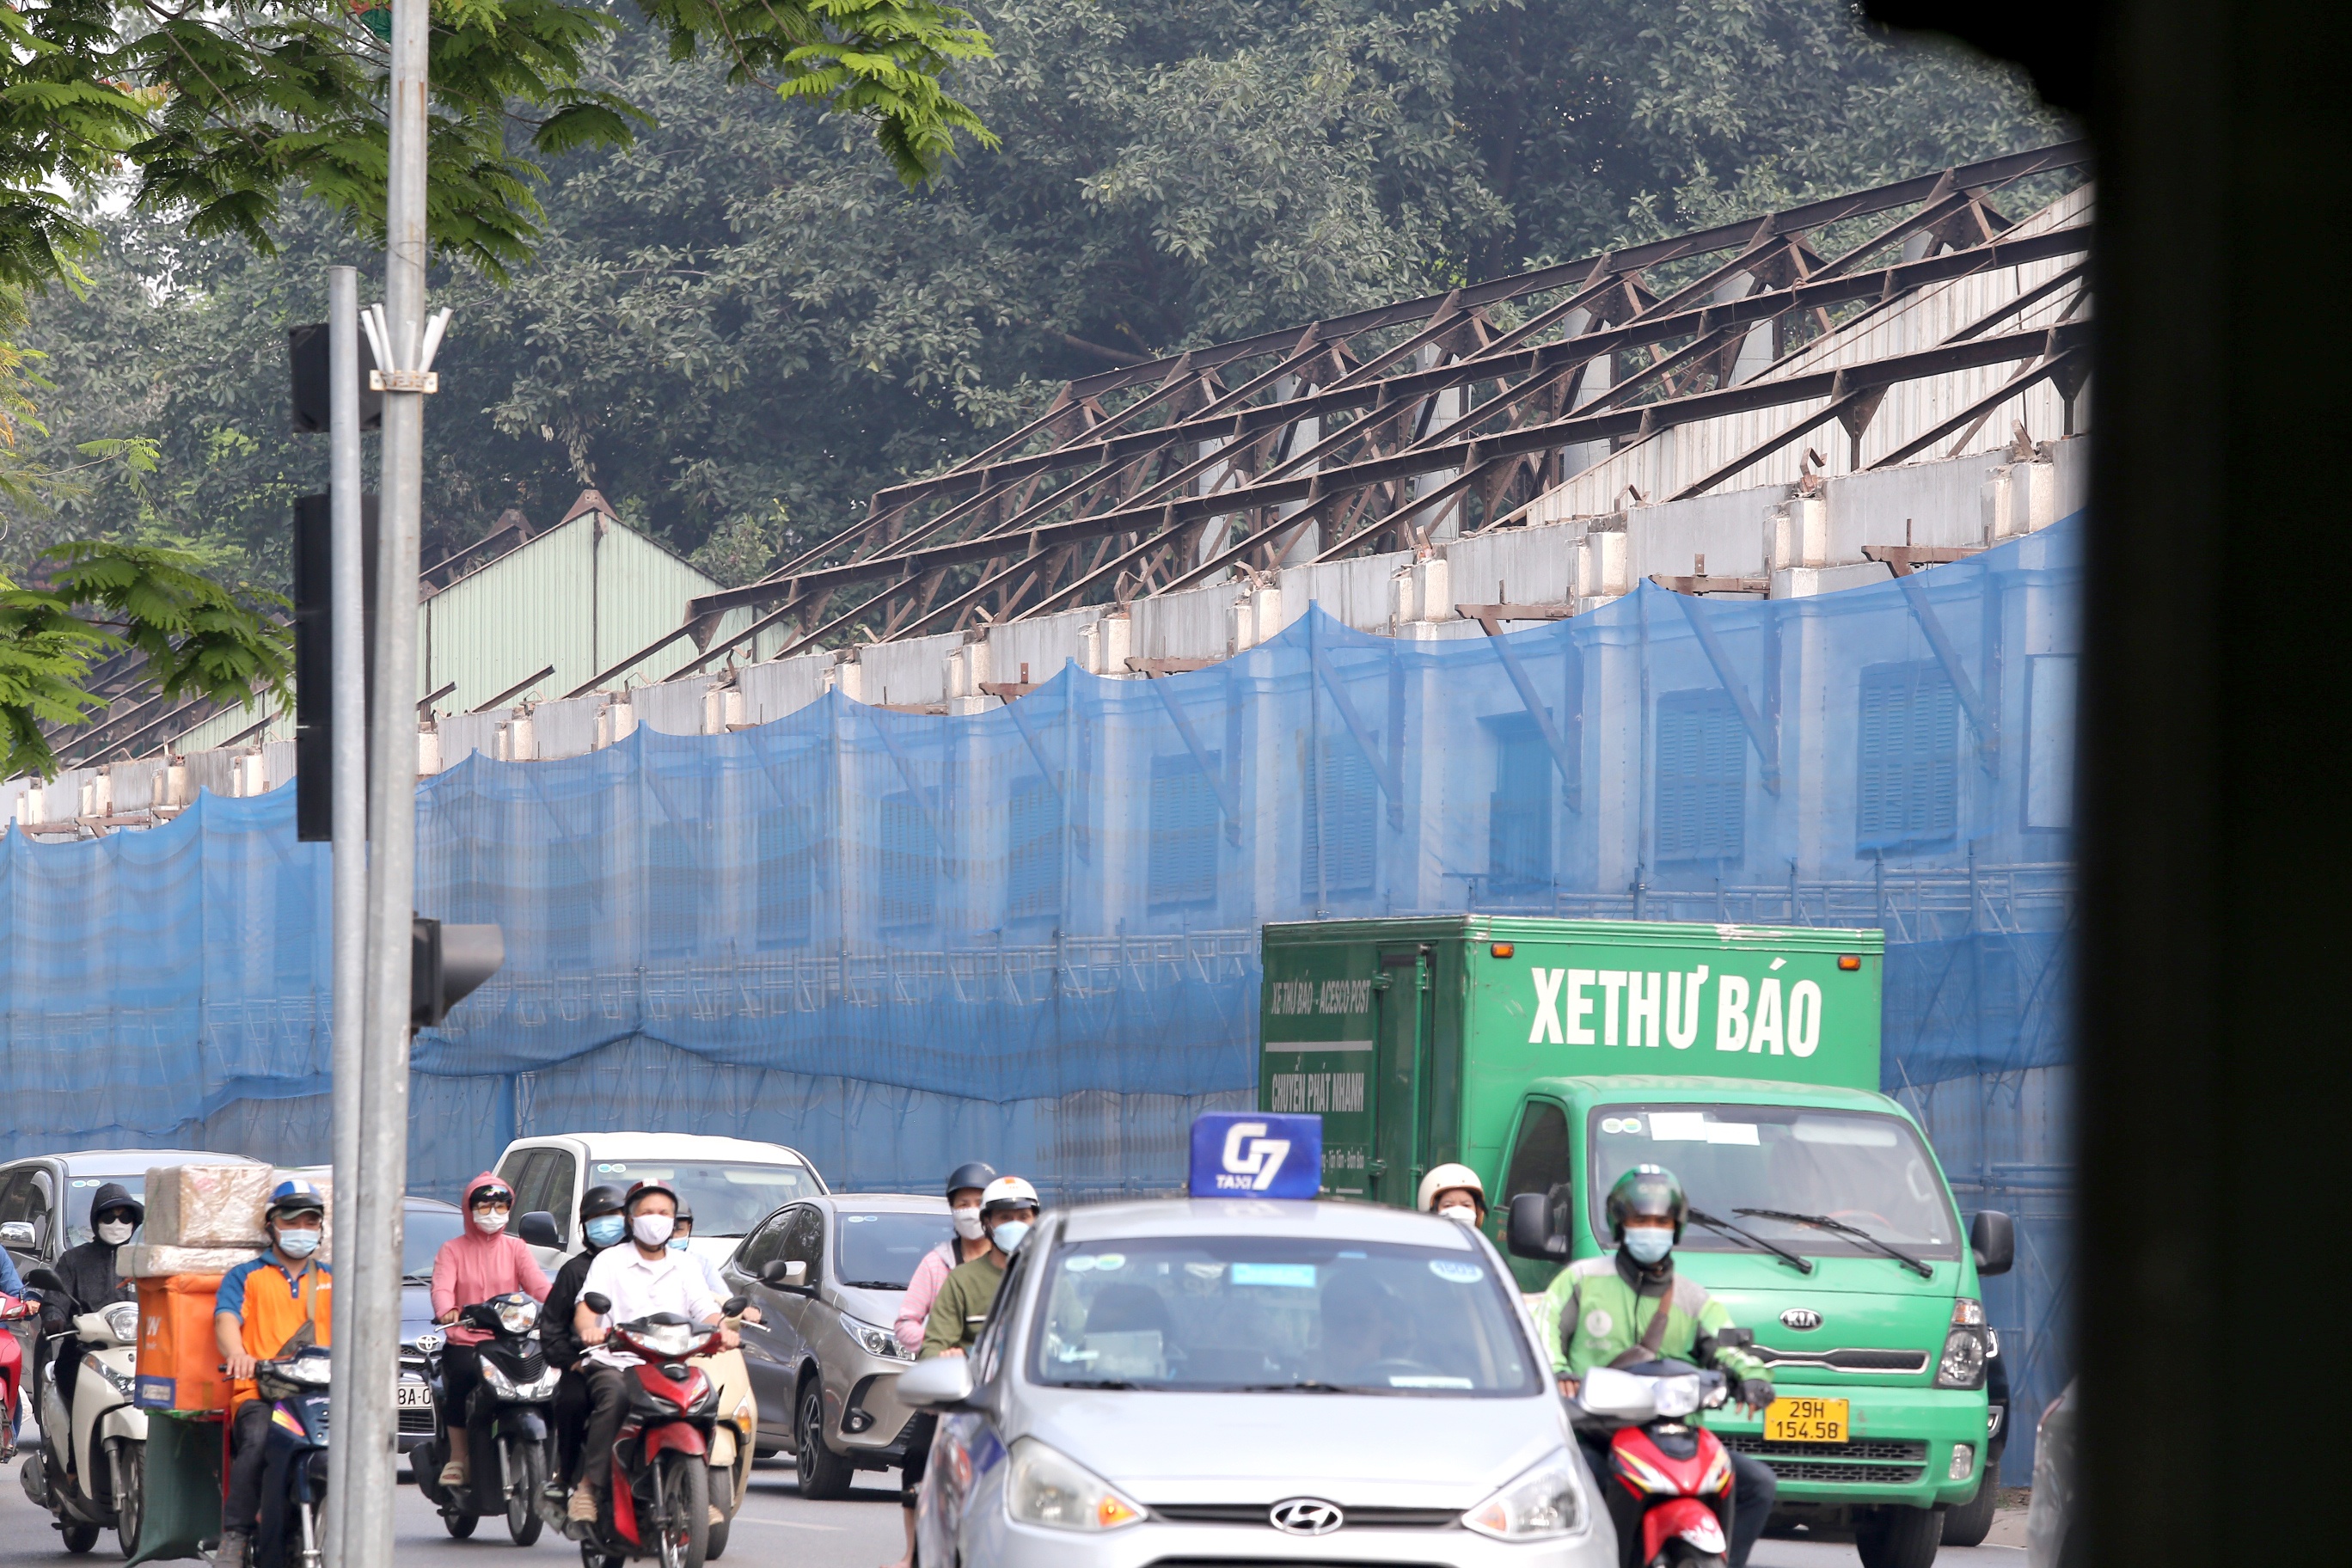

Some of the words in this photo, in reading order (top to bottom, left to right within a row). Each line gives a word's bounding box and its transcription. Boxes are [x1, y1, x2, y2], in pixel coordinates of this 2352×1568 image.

[1271, 982, 1282, 1014] XE
[1297, 970, 1313, 1015] BÁO
[1319, 980, 1350, 1014] ACESCO
[1350, 979, 1371, 1014] POST
[1715, 957, 1822, 1058] BÁO
[1271, 1056, 1306, 1112] CHUYỂN
[1308, 1062, 1332, 1112] PHÁT
[1332, 1073, 1365, 1112] NHANH
[1222, 1122, 1291, 1191] G7
[1216, 1174, 1253, 1191] TAXI
[1784, 1311, 1818, 1327] KIA
[397, 1387, 432, 1406] 8A-0
[1789, 1400, 1825, 1418] 29H
[1776, 1421, 1839, 1439] 154.58
